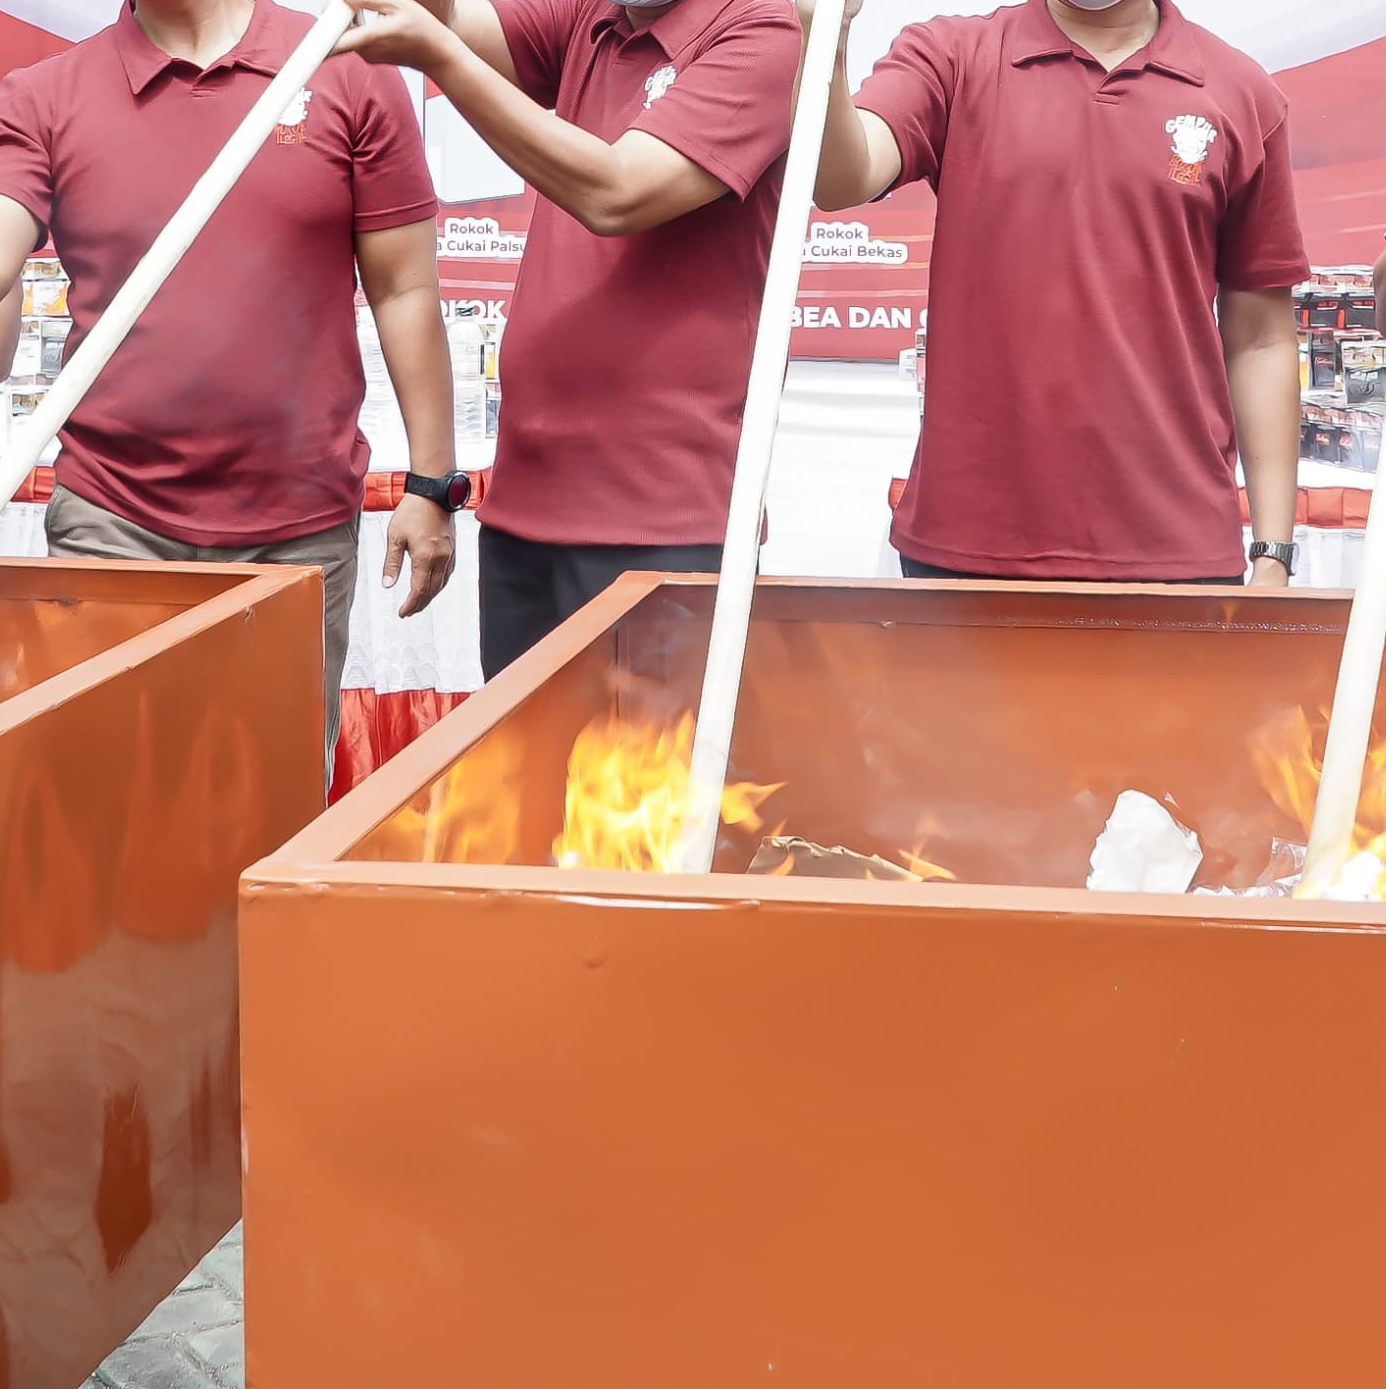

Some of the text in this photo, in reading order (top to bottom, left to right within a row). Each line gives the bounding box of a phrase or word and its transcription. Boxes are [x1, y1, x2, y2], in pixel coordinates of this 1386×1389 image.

[449, 222, 494, 235] Rokok
[816, 227, 863, 240] Rokok
[446, 239, 486, 252] Cukai
[810, 244, 852, 258] Cukai
[857, 245, 903, 259] Bekas
[789, 306, 842, 329] BEA
[848, 306, 912, 329] DAN
